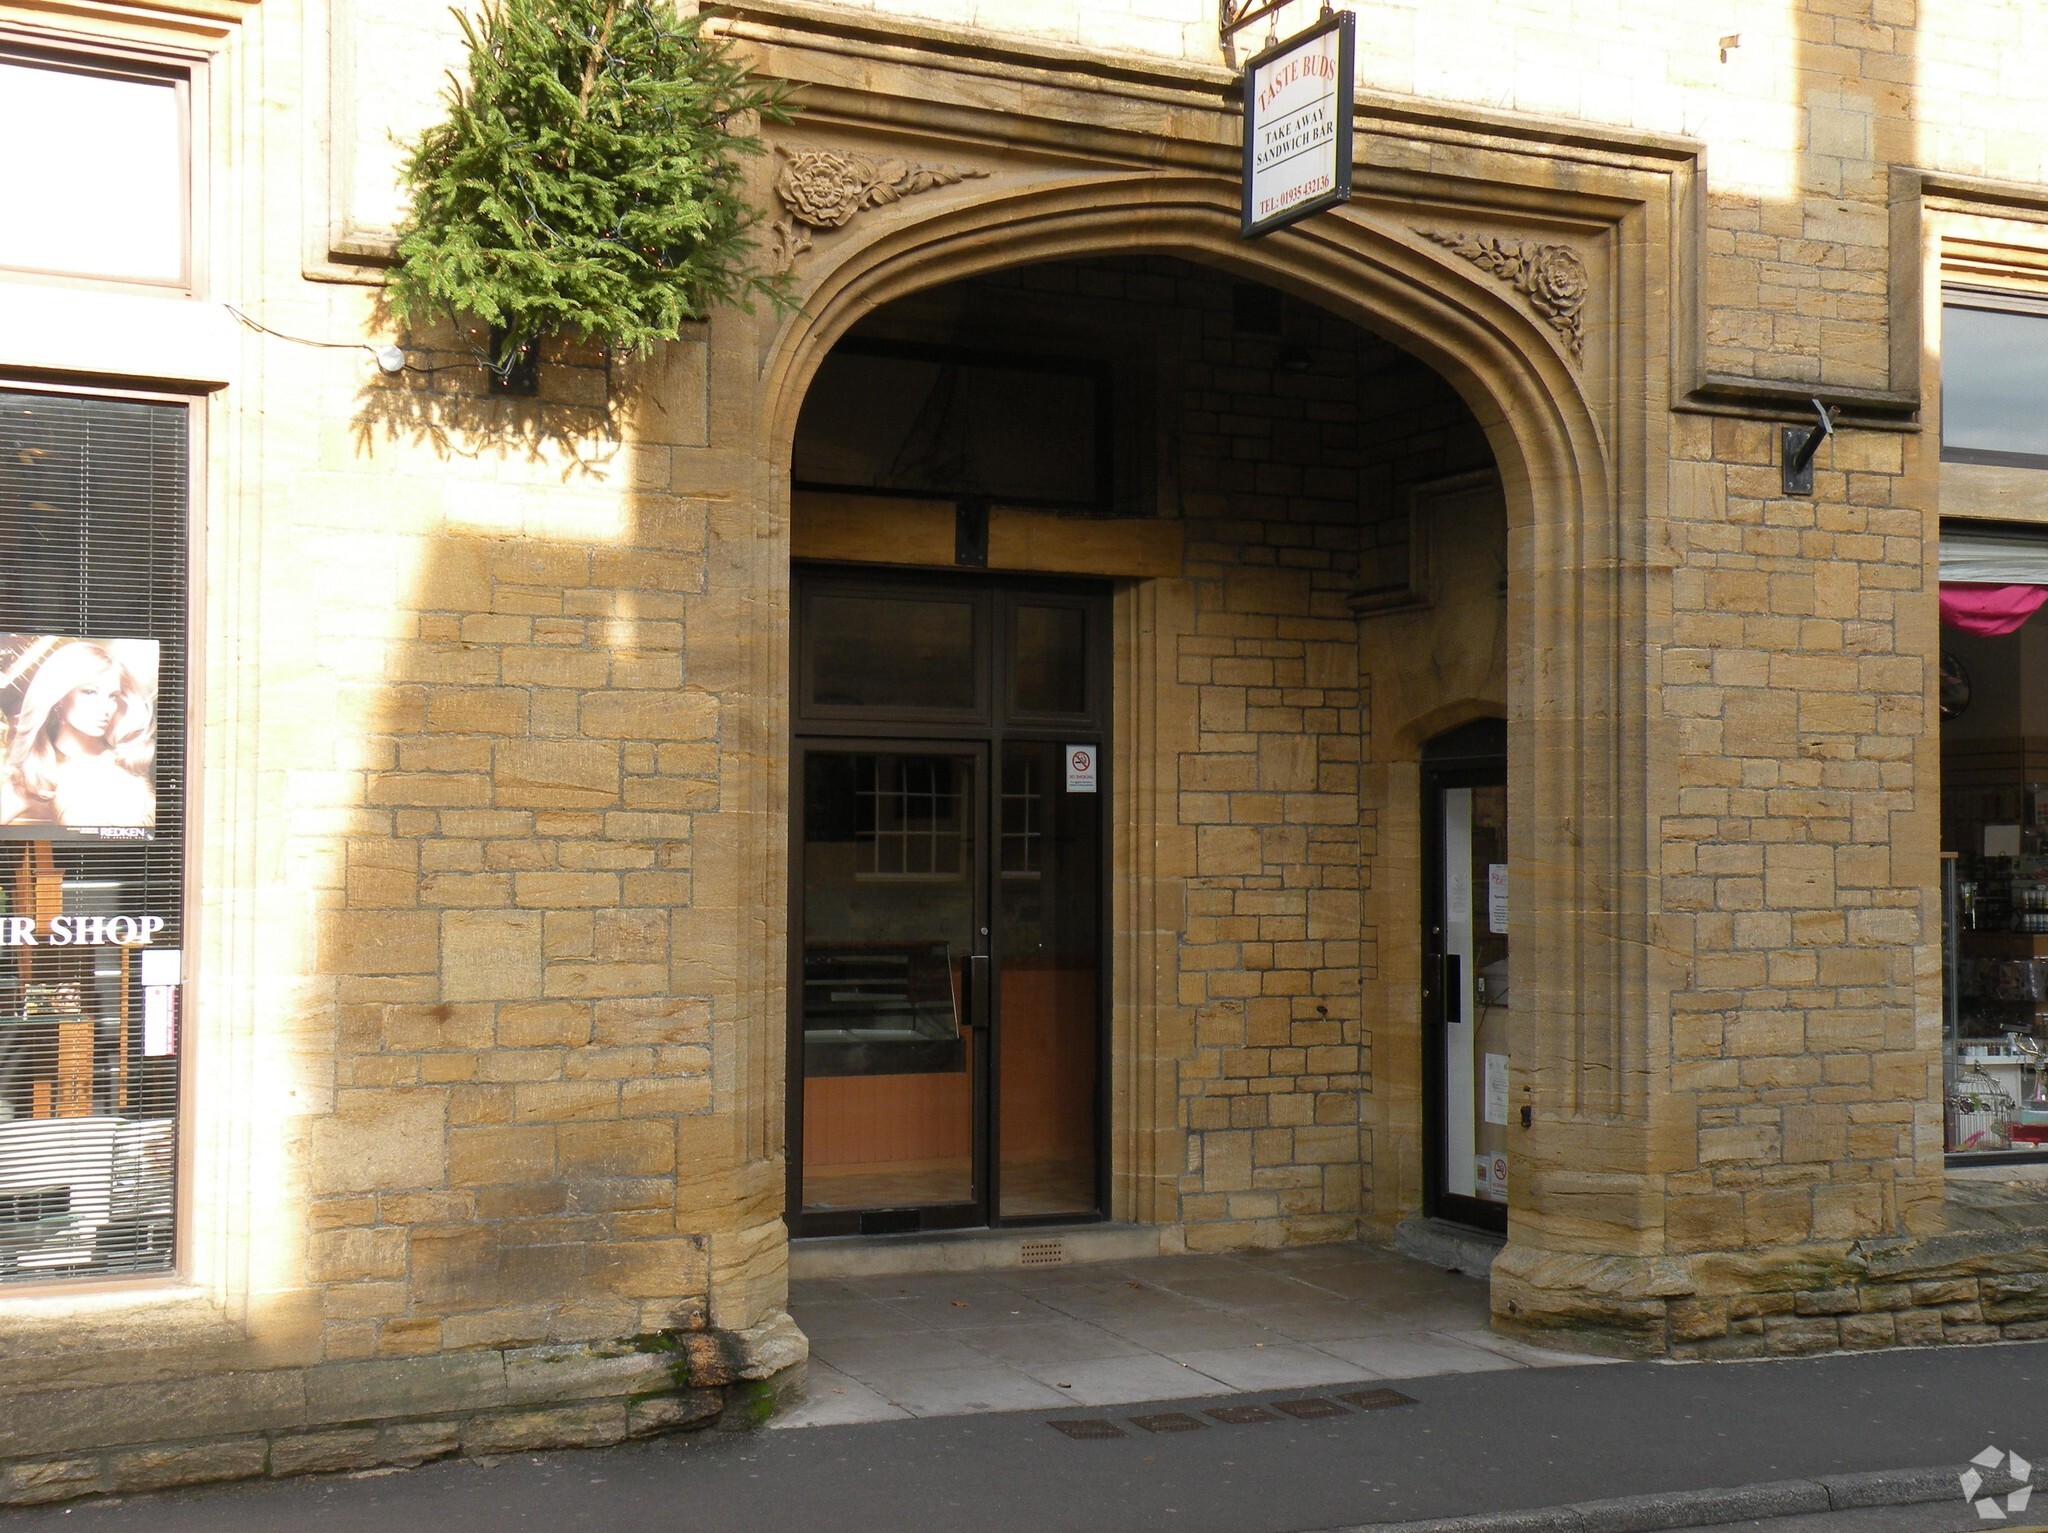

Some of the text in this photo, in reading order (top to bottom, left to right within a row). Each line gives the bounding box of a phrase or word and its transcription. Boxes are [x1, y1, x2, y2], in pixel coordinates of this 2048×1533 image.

[1258, 55, 1336, 112] TASTE BUDS
[1257, 121, 1333, 166] SANDWICH BAR
[1265, 106, 1325, 145] TAKE AWAY
[1260, 174, 1330, 214] TEL: 01935 432136
[100, 827, 145, 837] REDKEN
[50, 915, 164, 946] SHOP
